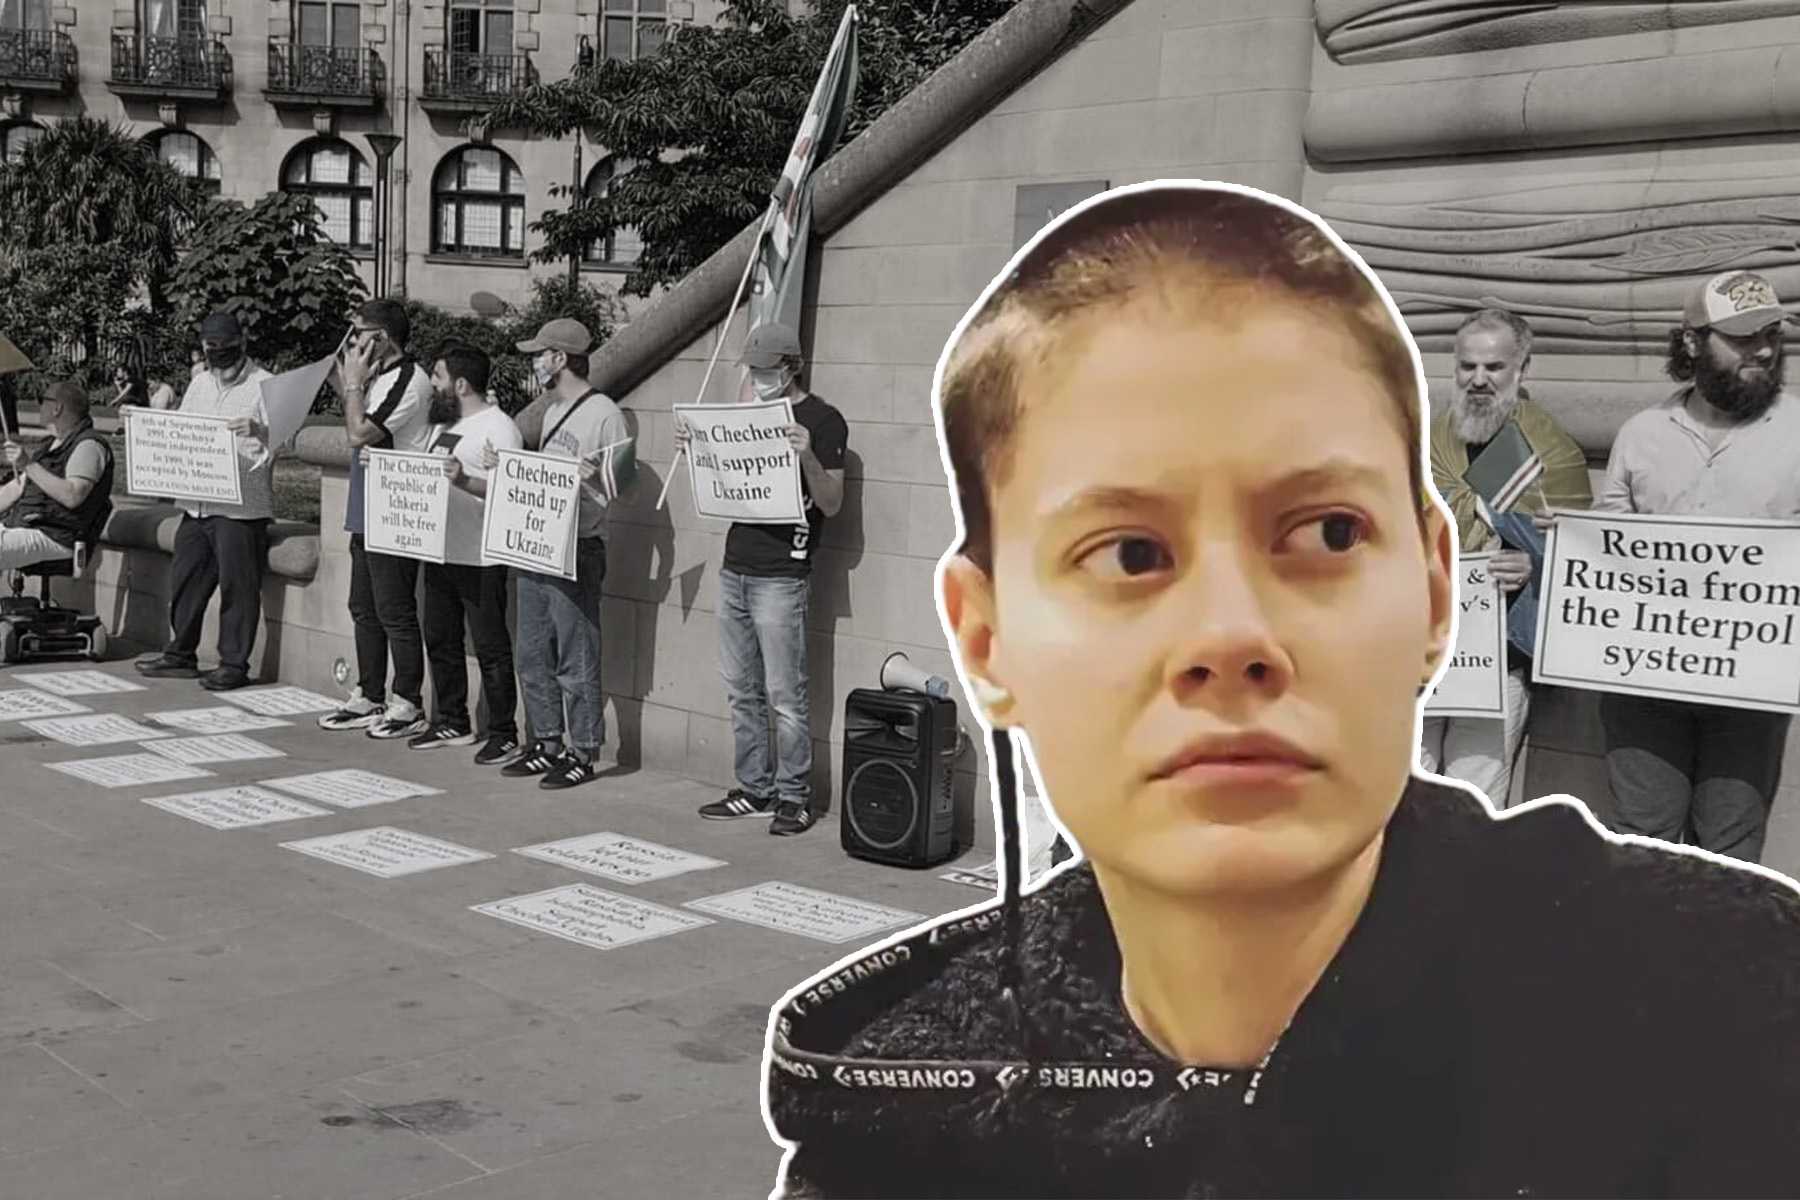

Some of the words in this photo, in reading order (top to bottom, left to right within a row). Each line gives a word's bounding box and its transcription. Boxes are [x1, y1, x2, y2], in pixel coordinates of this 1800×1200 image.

[169, 418, 217, 431] September
[711, 424, 787, 443] Chechen
[378, 457, 396, 472] The
[398, 459, 442, 477] Chechen
[505, 458, 574, 489] Chechens
[713, 453, 720, 471] I
[723, 451, 791, 477] support
[381, 475, 424, 494] Republic
[427, 480, 438, 496] of
[712, 480, 772, 500] Ukraine
[389, 494, 429, 513] Ichkeria
[507, 485, 545, 508] stand
[550, 496, 567, 519] up
[382, 511, 400, 526] will
[402, 513, 415, 529] be
[417, 516, 437, 532] free
[525, 509, 545, 533] for
[394, 532, 422, 551] again
[1601, 528, 1764, 566] Remove
[1467, 568, 1486, 585] &
[1563, 558, 1690, 599] Russia
[1703, 571, 1800, 606] from
[1562, 596, 1620, 628] the
[1633, 602, 1795, 651] Interpol
[1603, 643, 1737, 678] system
[806, 946, 911, 1006] CONVERSE
[852, 1070, 976, 1088] CONVERSE
